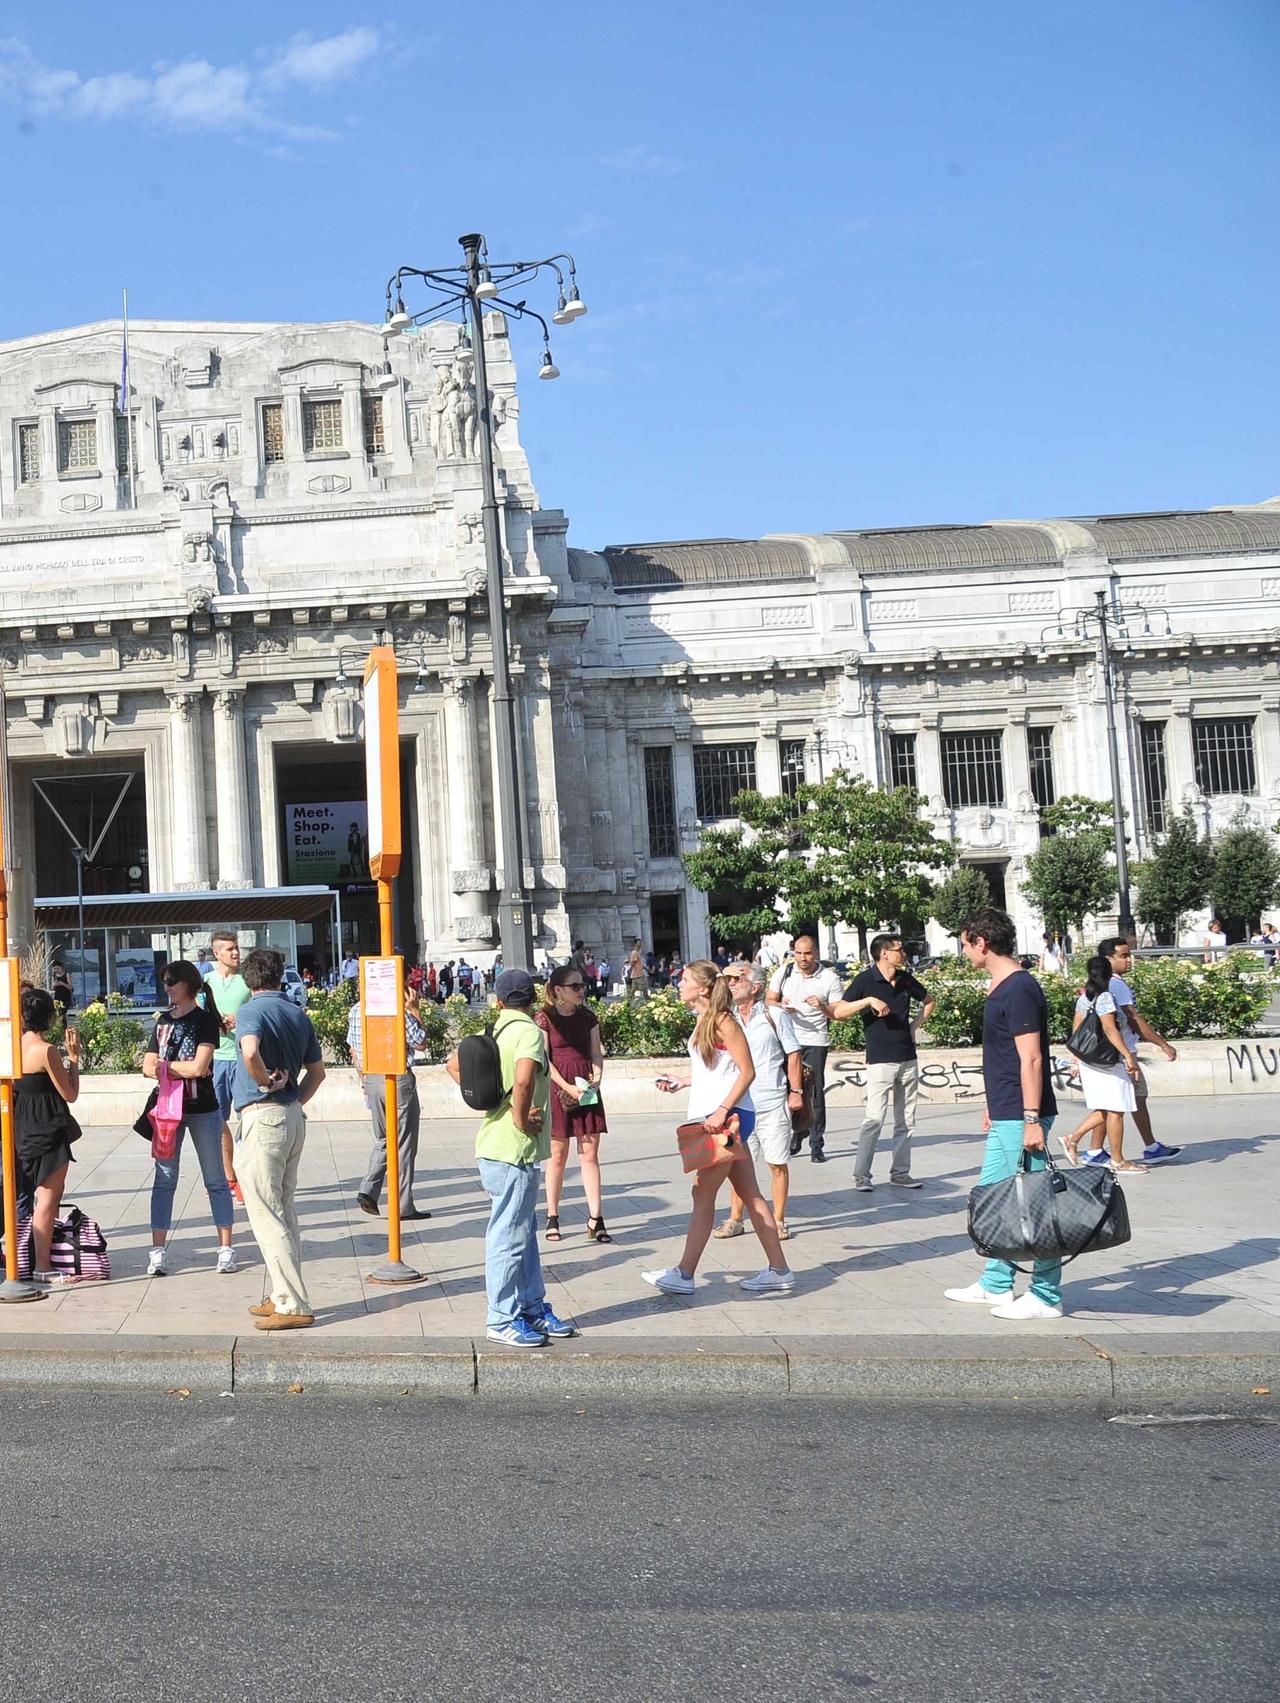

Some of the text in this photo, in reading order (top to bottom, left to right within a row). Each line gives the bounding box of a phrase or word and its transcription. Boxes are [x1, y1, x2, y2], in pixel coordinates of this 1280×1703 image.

[293, 807, 334, 818] Meet.
[294, 820, 335, 834] Shop.
[294, 834, 321, 846] Eat.
[1226, 1044, 1280, 1084] MU
